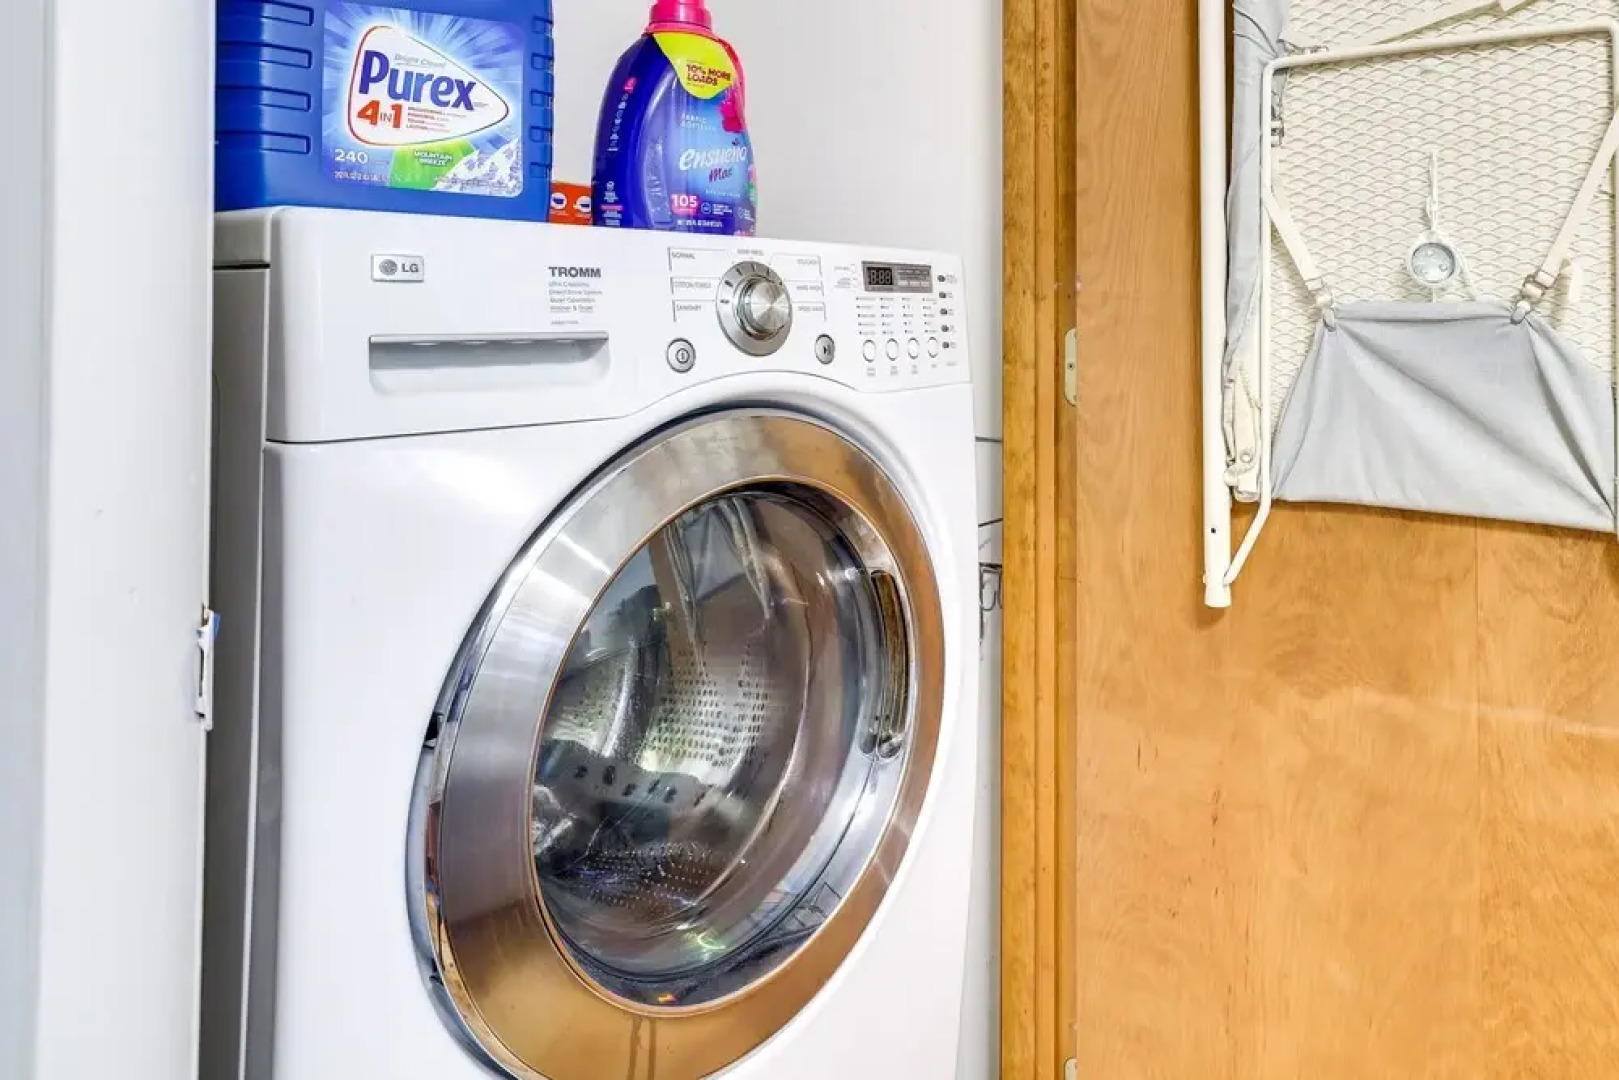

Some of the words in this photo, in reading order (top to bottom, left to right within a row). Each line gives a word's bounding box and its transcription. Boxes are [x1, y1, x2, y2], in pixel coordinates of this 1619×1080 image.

[686, 64, 706, 75] 10%
[708, 68, 731, 81] MORE
[686, 73, 718, 86] LOADS
[359, 50, 476, 110] Purex
[334, 149, 368, 163] 240
[671, 194, 699, 208] 105
[401, 263, 419, 273] LG
[548, 266, 602, 278] TROMM
